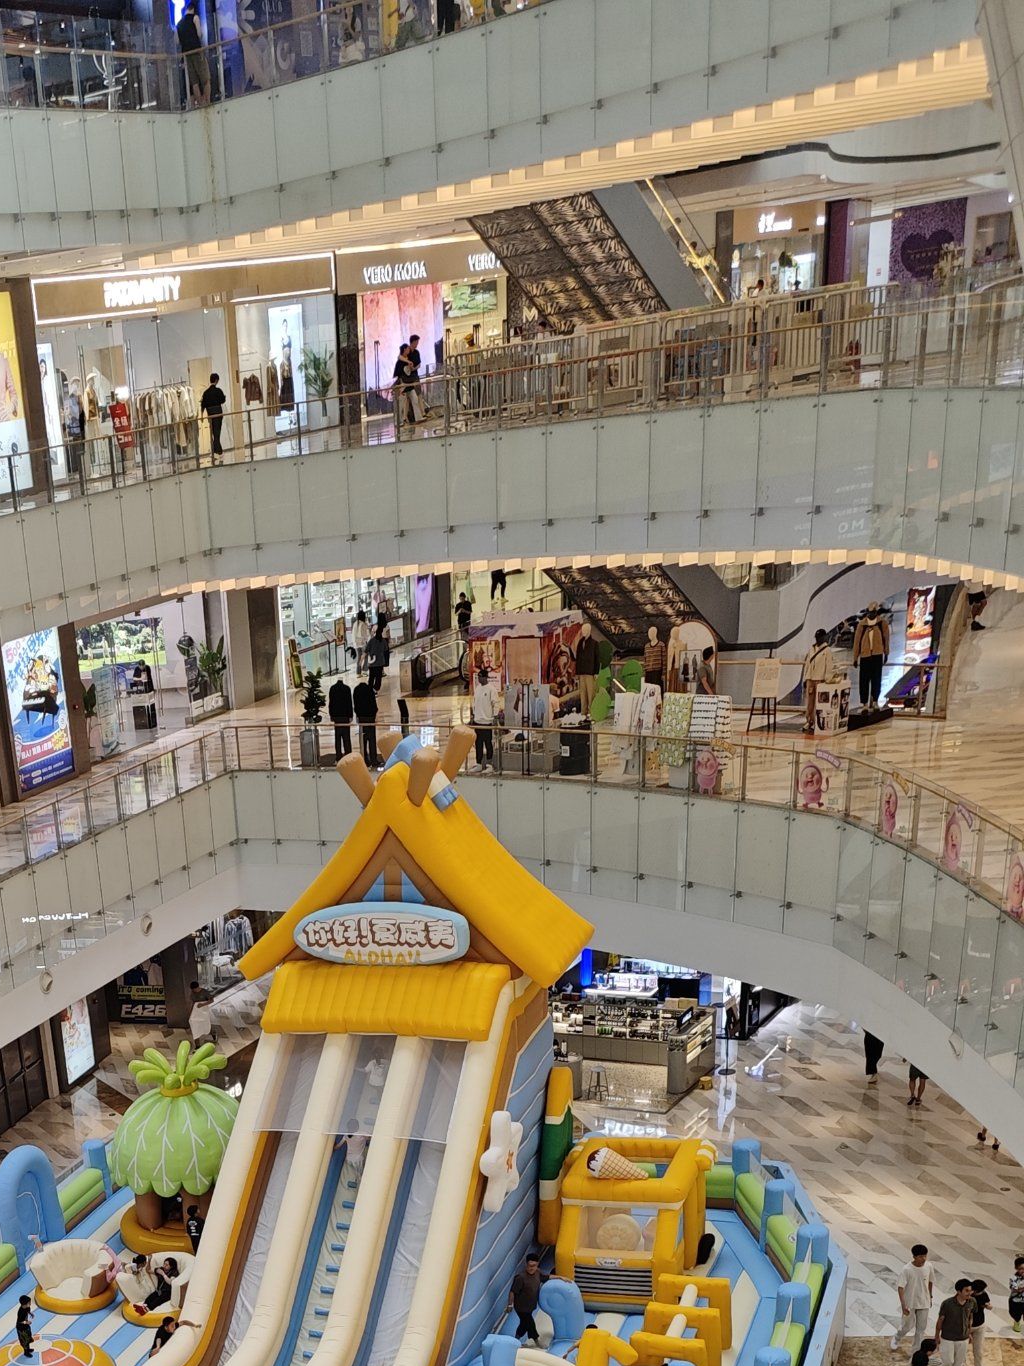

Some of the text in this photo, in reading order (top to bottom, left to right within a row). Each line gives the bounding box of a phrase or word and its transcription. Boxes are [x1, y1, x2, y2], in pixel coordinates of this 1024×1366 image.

[363, 260, 427, 285] VERO MODA
[468, 252, 496, 272] VERO
